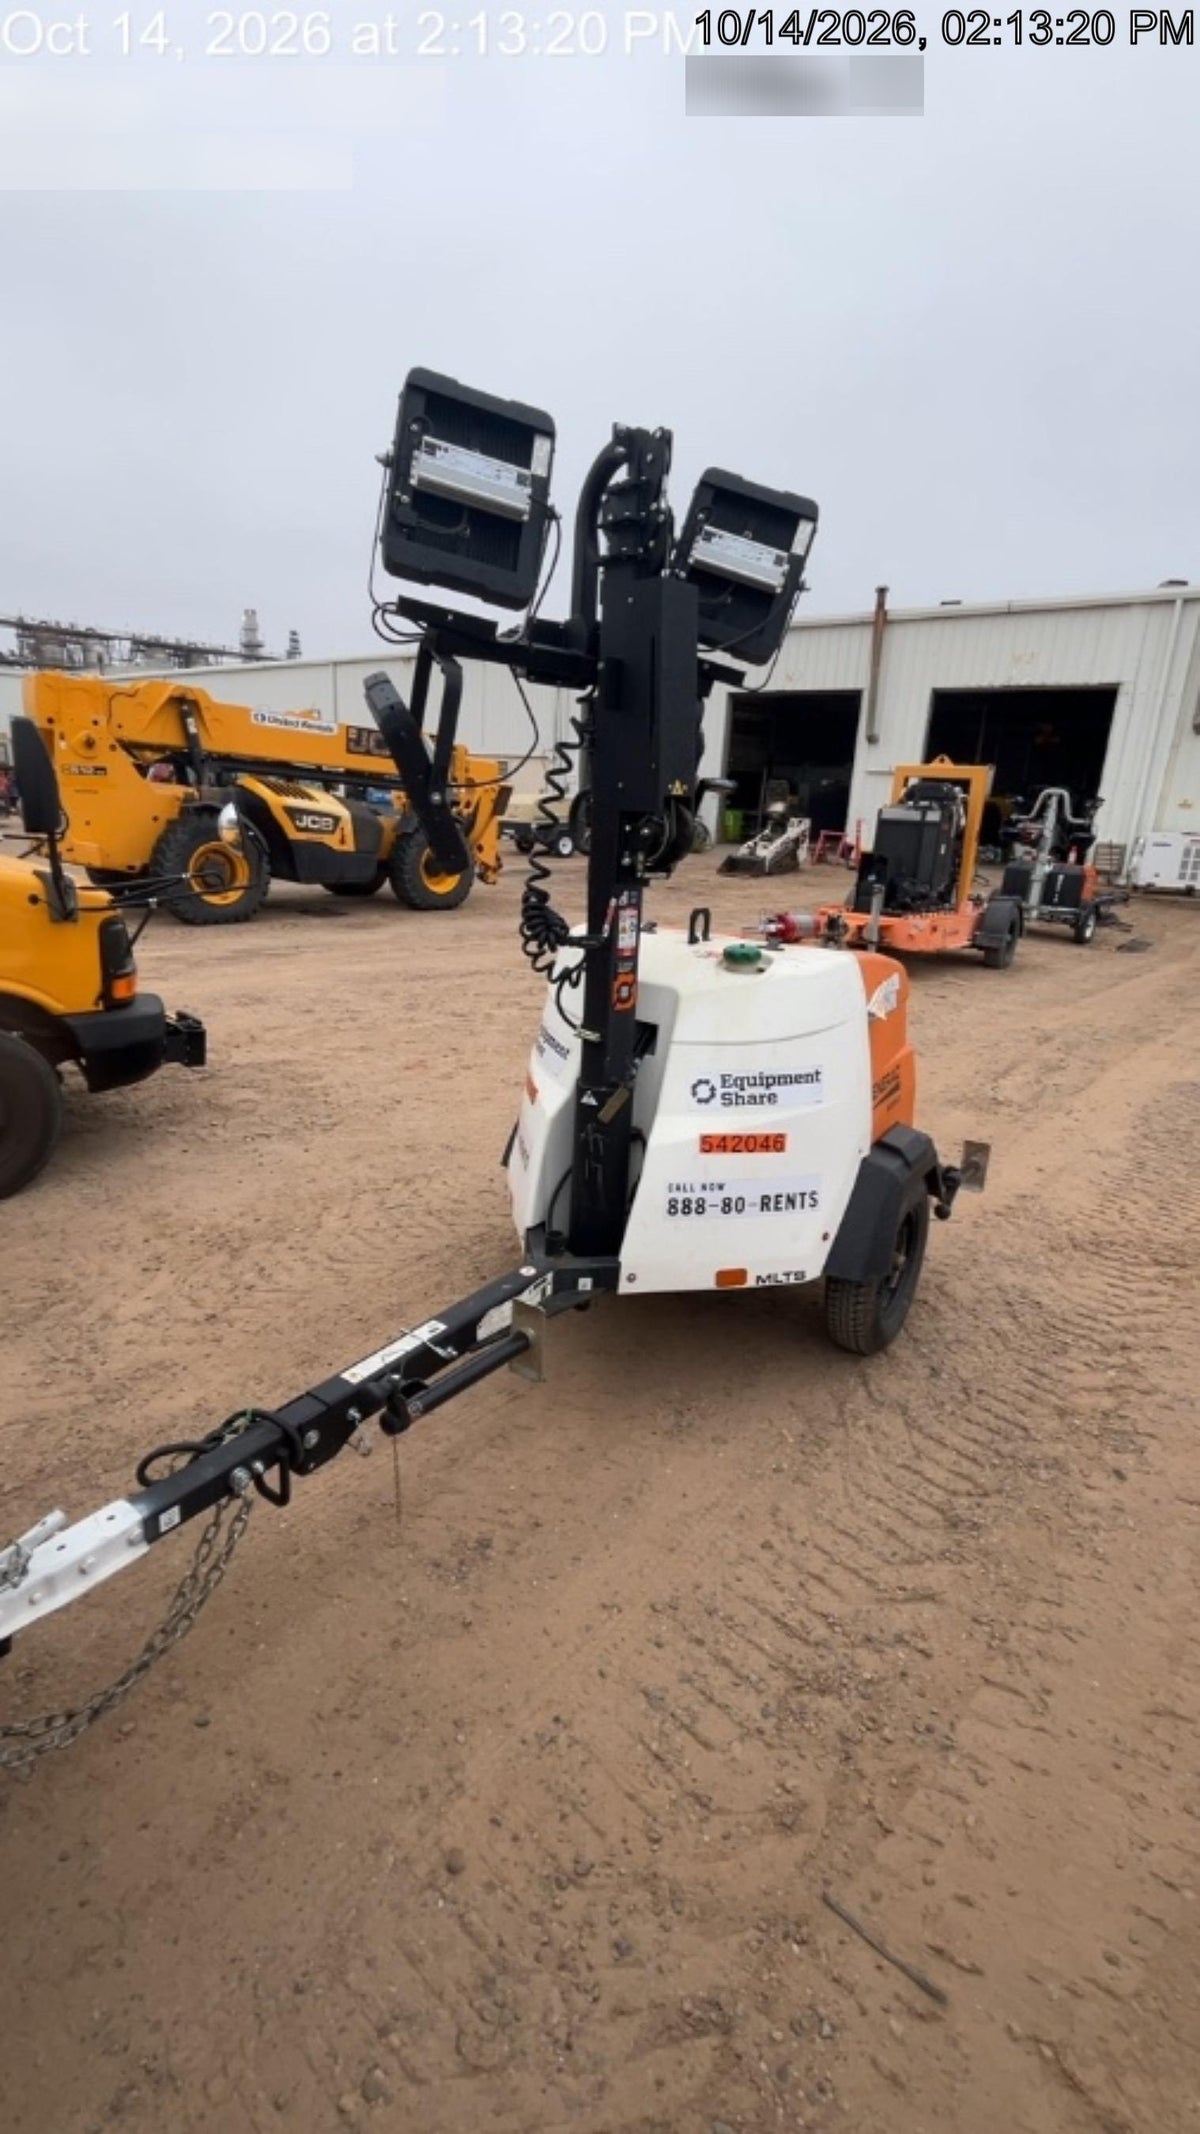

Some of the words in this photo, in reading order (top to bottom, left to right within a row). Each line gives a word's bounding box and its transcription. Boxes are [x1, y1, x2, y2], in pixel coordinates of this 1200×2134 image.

[296, 815, 334, 831] JCB
[720, 1069, 821, 1090] Equipment
[720, 1092, 778, 1107] Share
[701, 1134, 785, 1153] 542046
[667, 1183, 696, 1193] CALL
[701, 1182, 726, 1192] NOW
[667, 1190, 819, 1217] 888-80-RENTS
